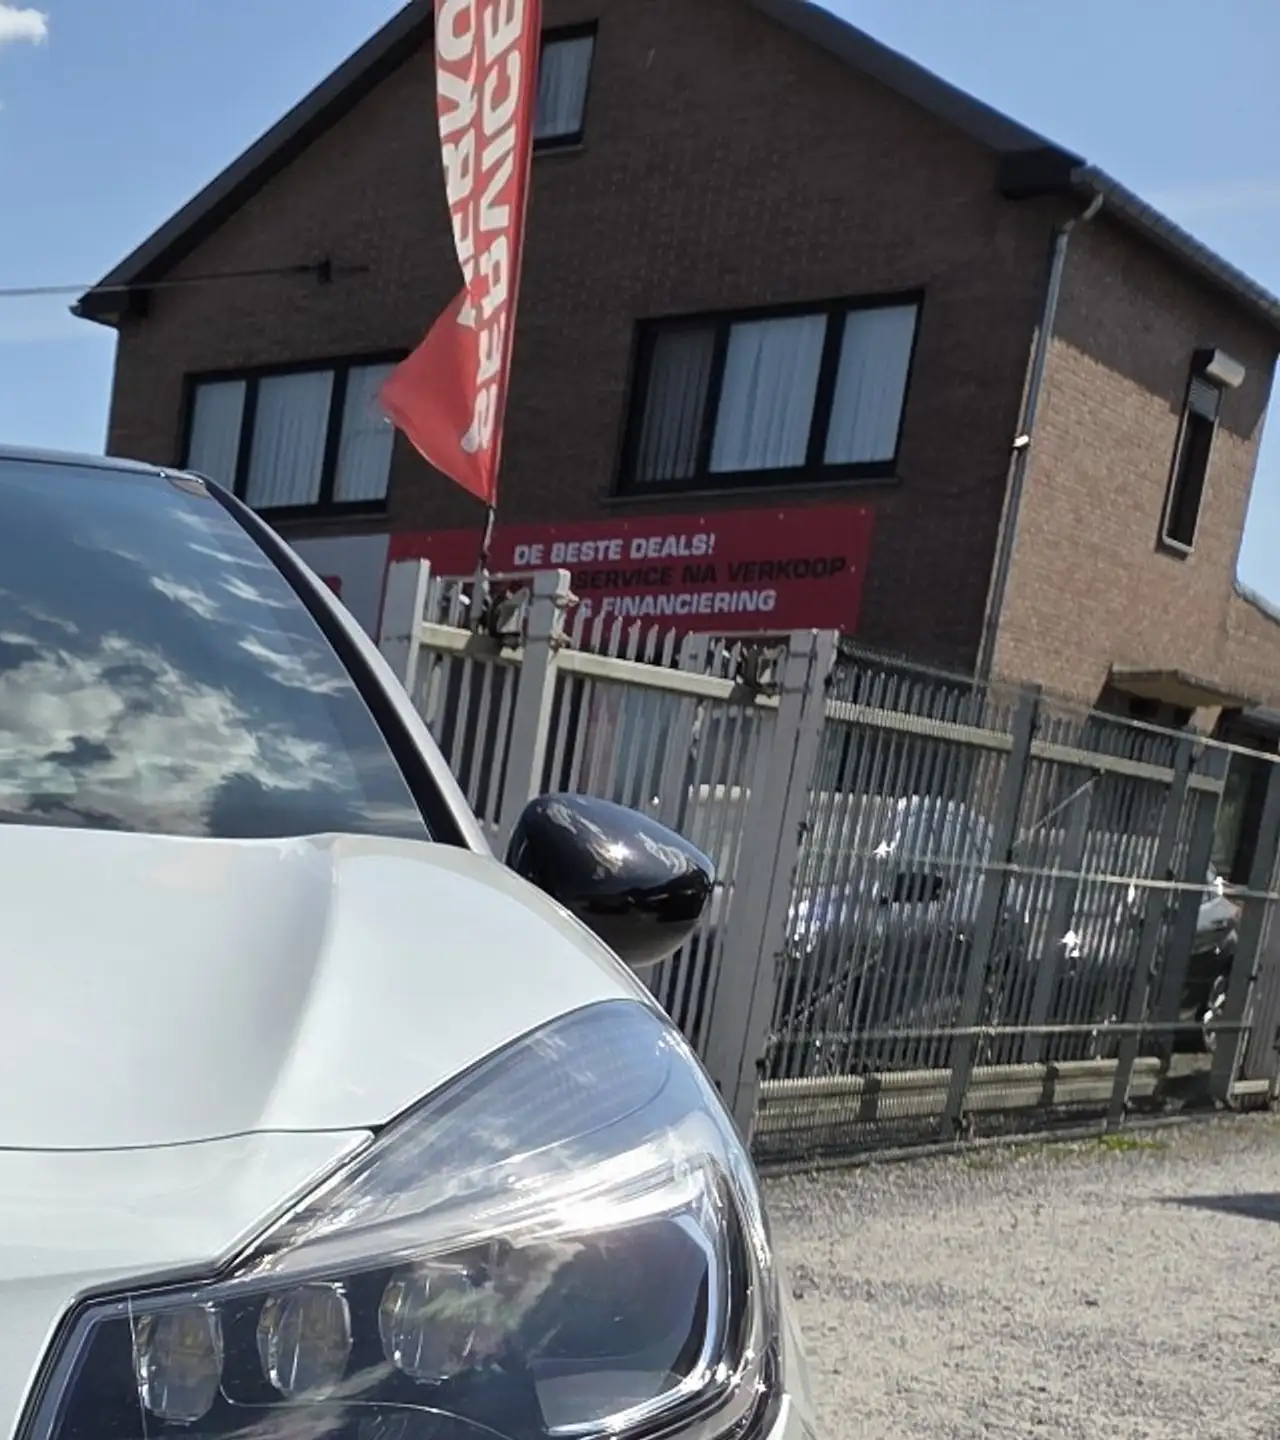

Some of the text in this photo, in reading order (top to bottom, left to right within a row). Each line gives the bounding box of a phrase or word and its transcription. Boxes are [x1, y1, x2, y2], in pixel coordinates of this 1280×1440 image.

[461, 0, 524, 454] SERVICE
[514, 532, 716, 566] DE BESTE DEALS!
[571, 556, 847, 591] SERVICE NA VERKOOP
[600, 589, 778, 617] FINANCIERING
